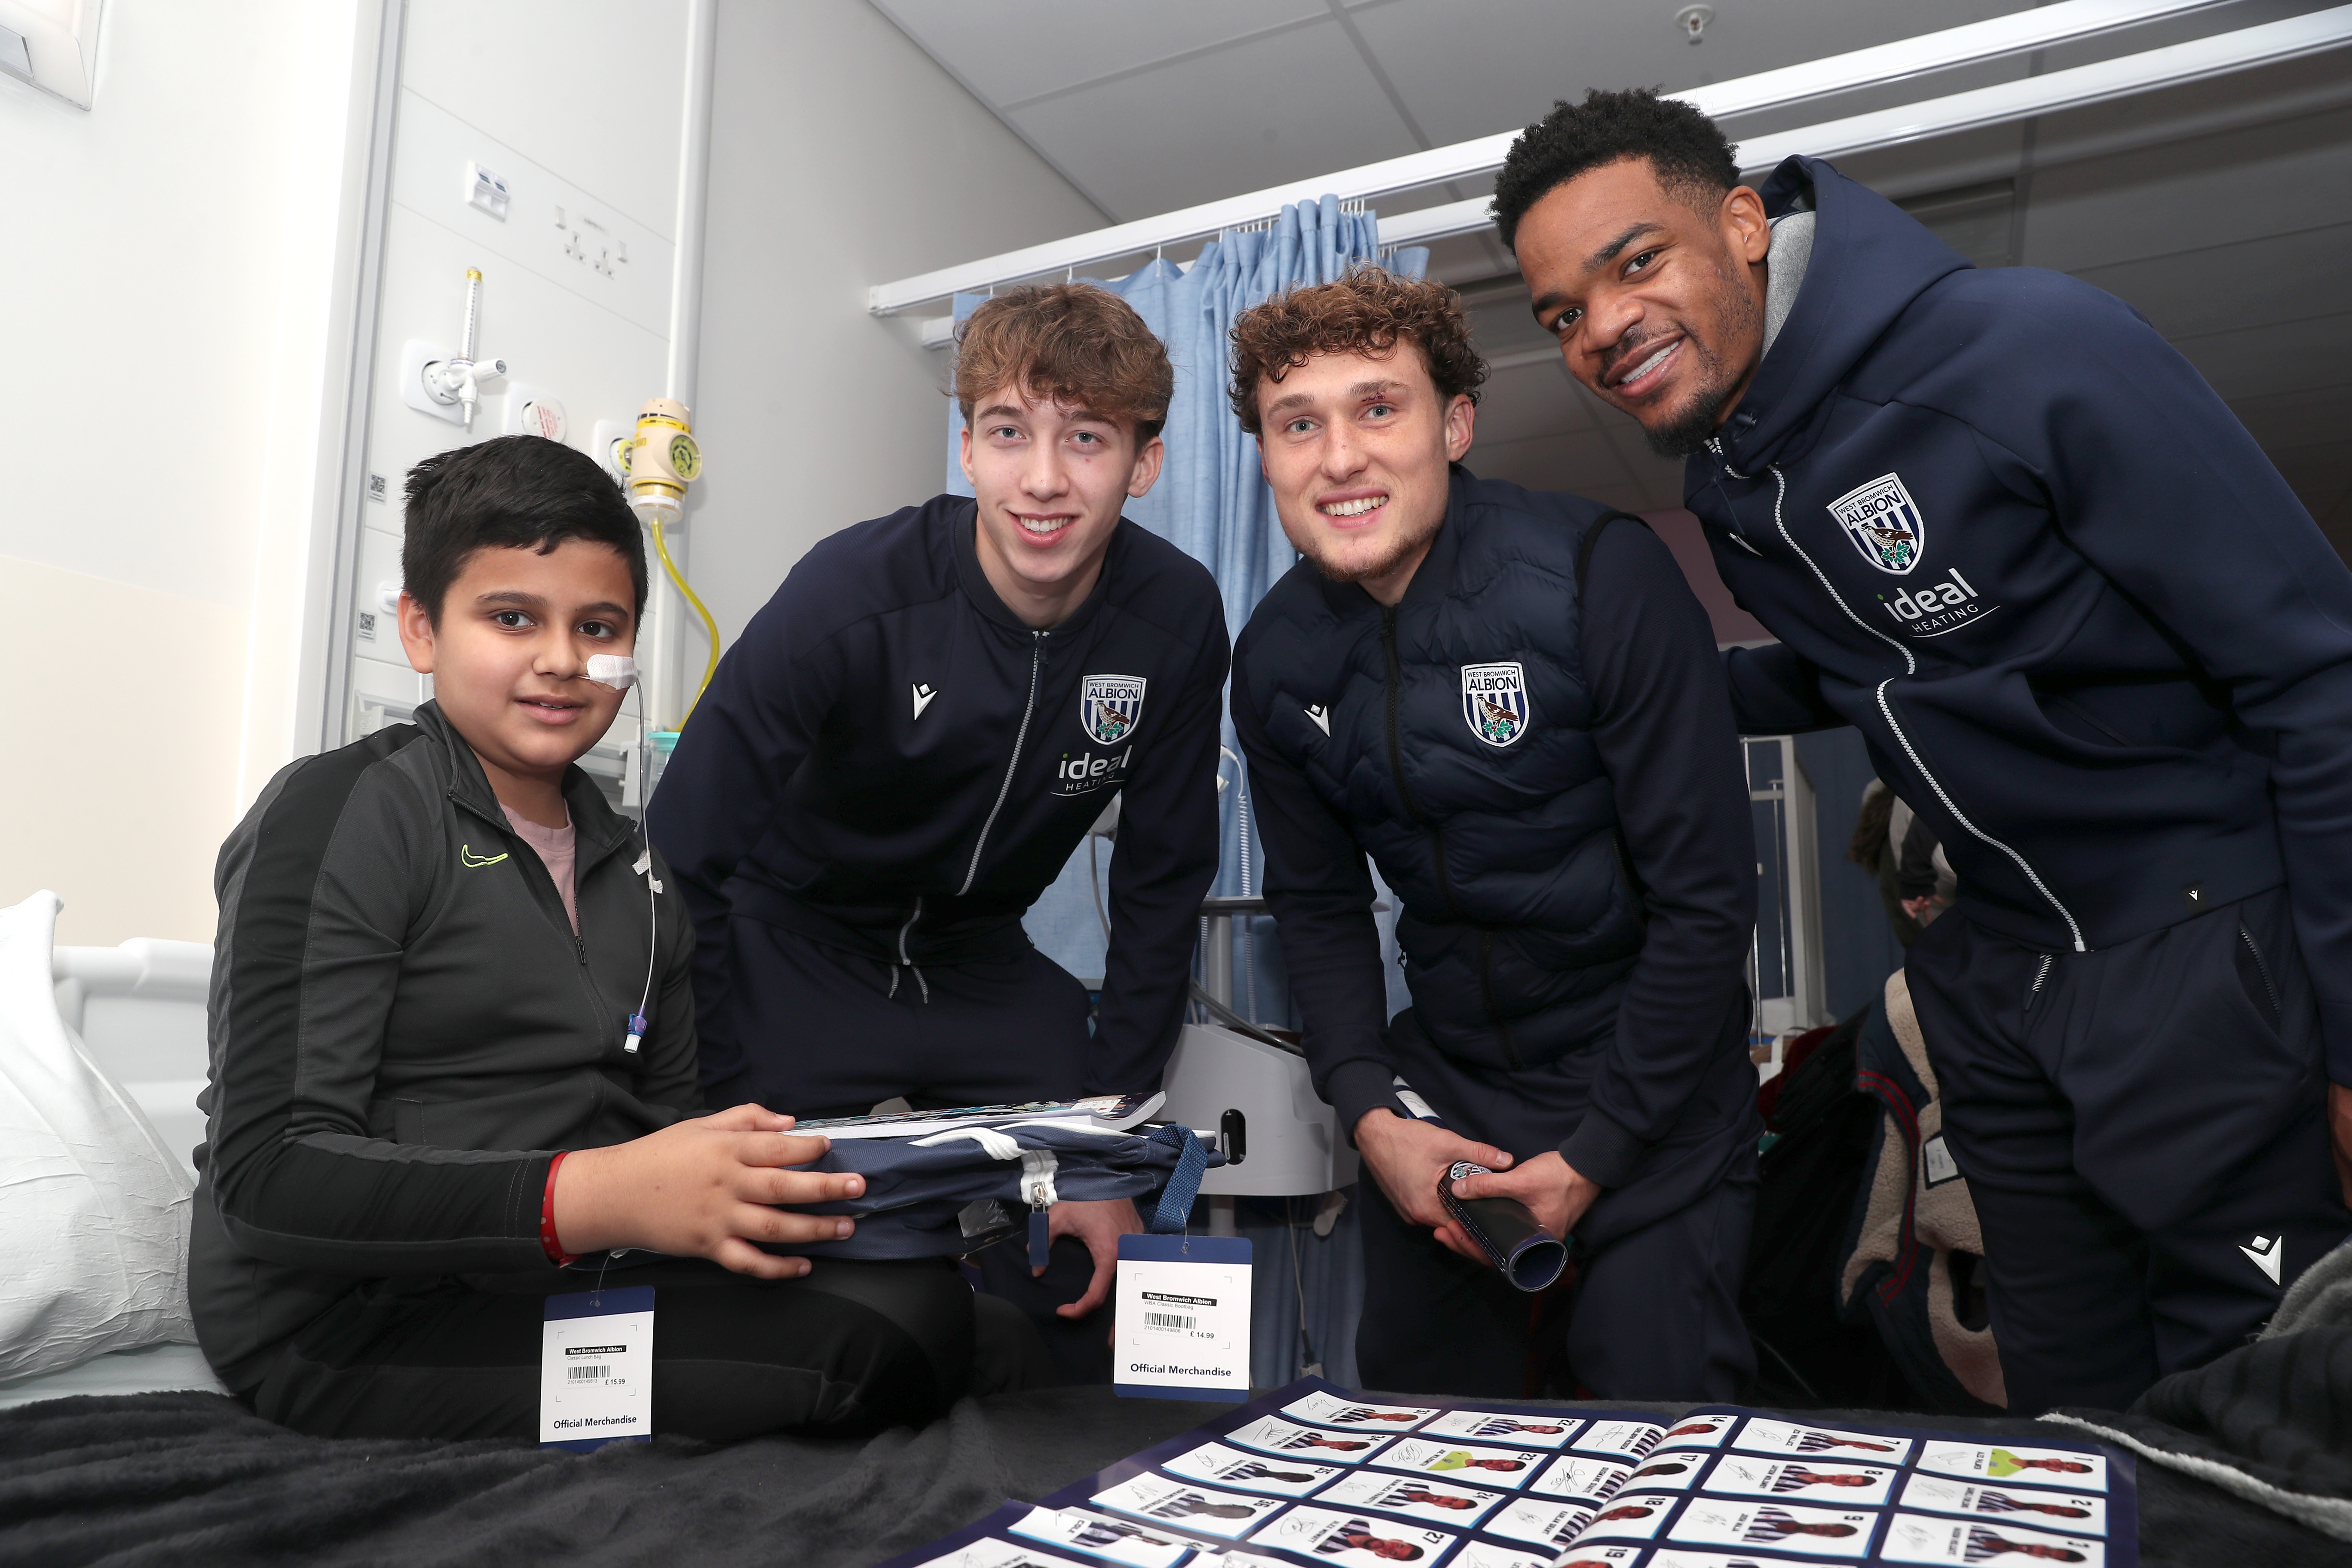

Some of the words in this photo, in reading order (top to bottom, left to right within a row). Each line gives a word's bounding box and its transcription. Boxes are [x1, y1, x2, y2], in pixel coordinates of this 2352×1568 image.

[1839, 502, 1856, 514] WEST
[1857, 484, 1894, 505] BROMWICH
[1847, 490, 1902, 527] ALBION
[1877, 568, 1978, 622] ideal
[1911, 604, 1978, 633] HEATING
[1469, 677, 1516, 690] ALBION
[1088, 689, 1138, 699] ALBION
[1059, 745, 1132, 779] ideal
[1066, 772, 1115, 791] HEATING
[1163, 1295, 1191, 1303] Bromwich
[1130, 1364, 1165, 1373] Official
[1169, 1366, 1231, 1376] Merchandise
[554, 1419, 582, 1429] Official
[585, 1415, 637, 1427] Merchandise
[1253, 1499, 1275, 1507] 36
[1422, 1531, 1445, 1544] 27
[1605, 1549, 1628, 1558] 19
